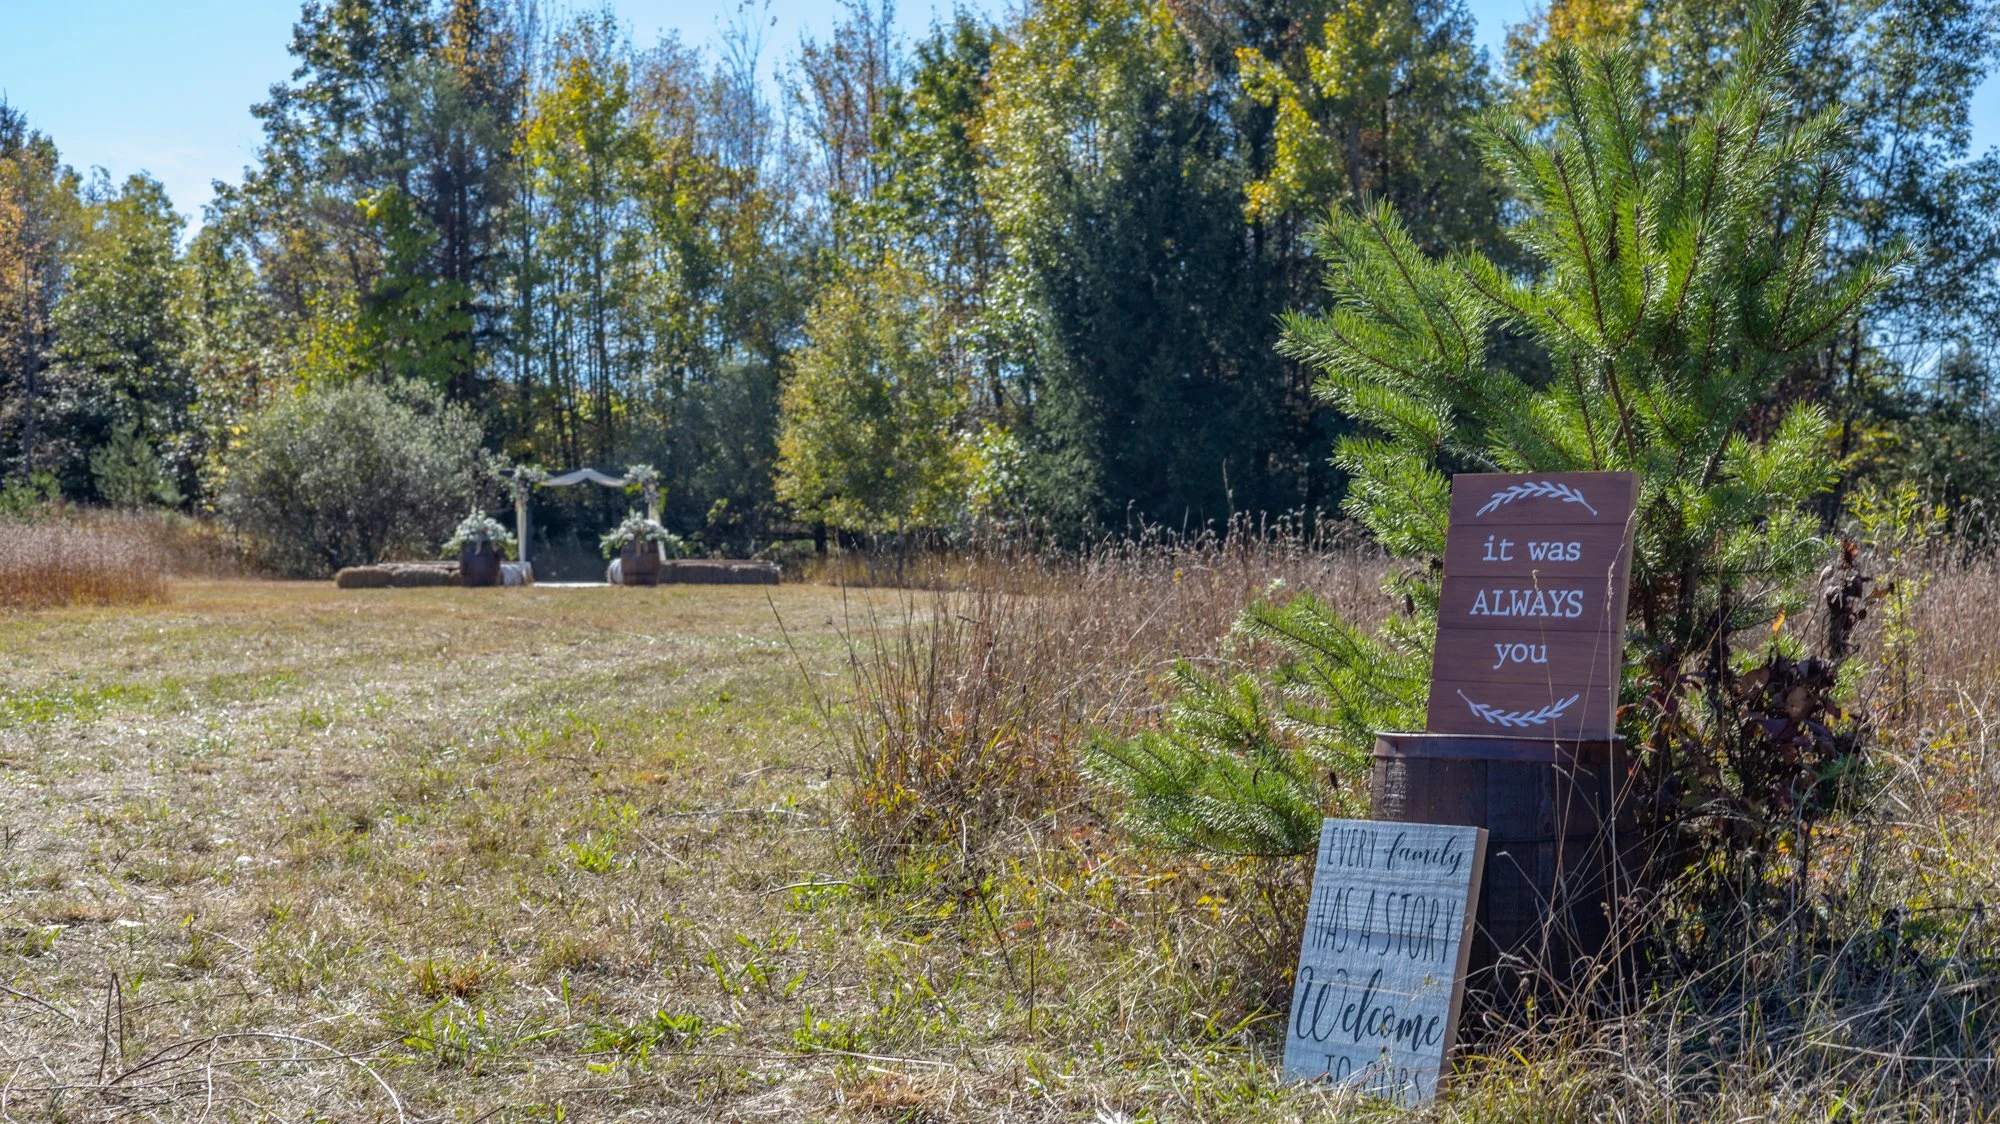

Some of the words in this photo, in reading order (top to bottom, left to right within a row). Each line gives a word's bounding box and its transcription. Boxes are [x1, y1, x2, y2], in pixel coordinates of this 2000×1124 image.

[1482, 534, 1514, 562] it
[1527, 541, 1581, 562] was
[1469, 589, 1584, 618] ALWAYS
[1492, 642, 1548, 670] you
[1327, 826, 1379, 868] EVERY
[1384, 831, 1464, 876] family
[1312, 885, 1354, 953] HAS
[1357, 888, 1376, 953] A
[1378, 892, 1457, 964] STORY
[1295, 966, 1444, 1052] Welcome
[1325, 1054, 1351, 1086] TO
